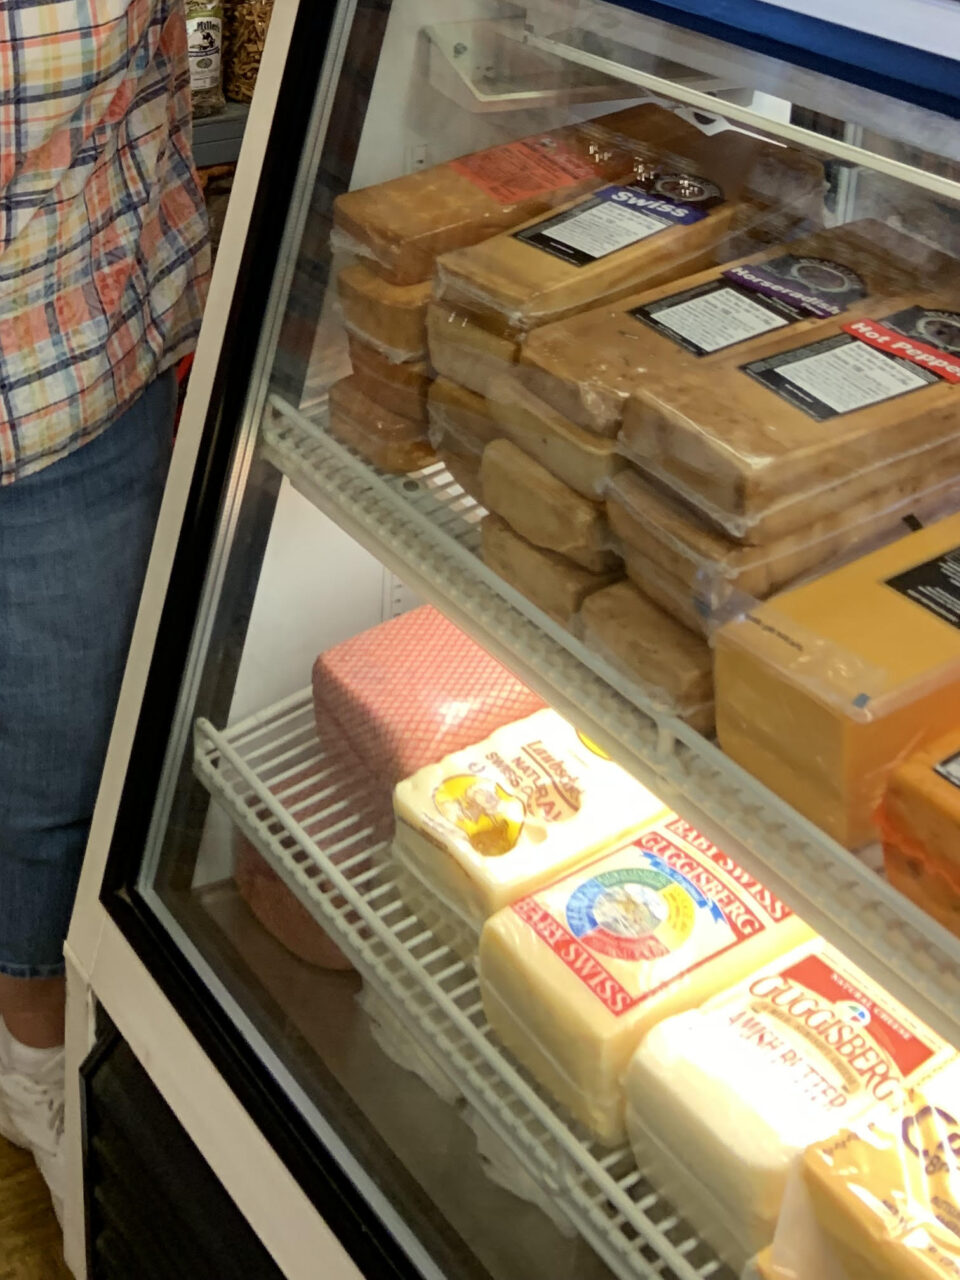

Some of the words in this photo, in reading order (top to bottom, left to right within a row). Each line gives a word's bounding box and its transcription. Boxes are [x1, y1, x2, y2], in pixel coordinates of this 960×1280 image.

[611, 191, 689, 218] Swiss
[851, 322, 890, 344] Hot
[891, 341, 960, 377] Peppe
[641, 832, 761, 936] GUGGISBERG
[717, 851, 788, 922] SWISS
[561, 939, 633, 1015] SWISS
[749, 974, 901, 1101] GUGGISBERG
